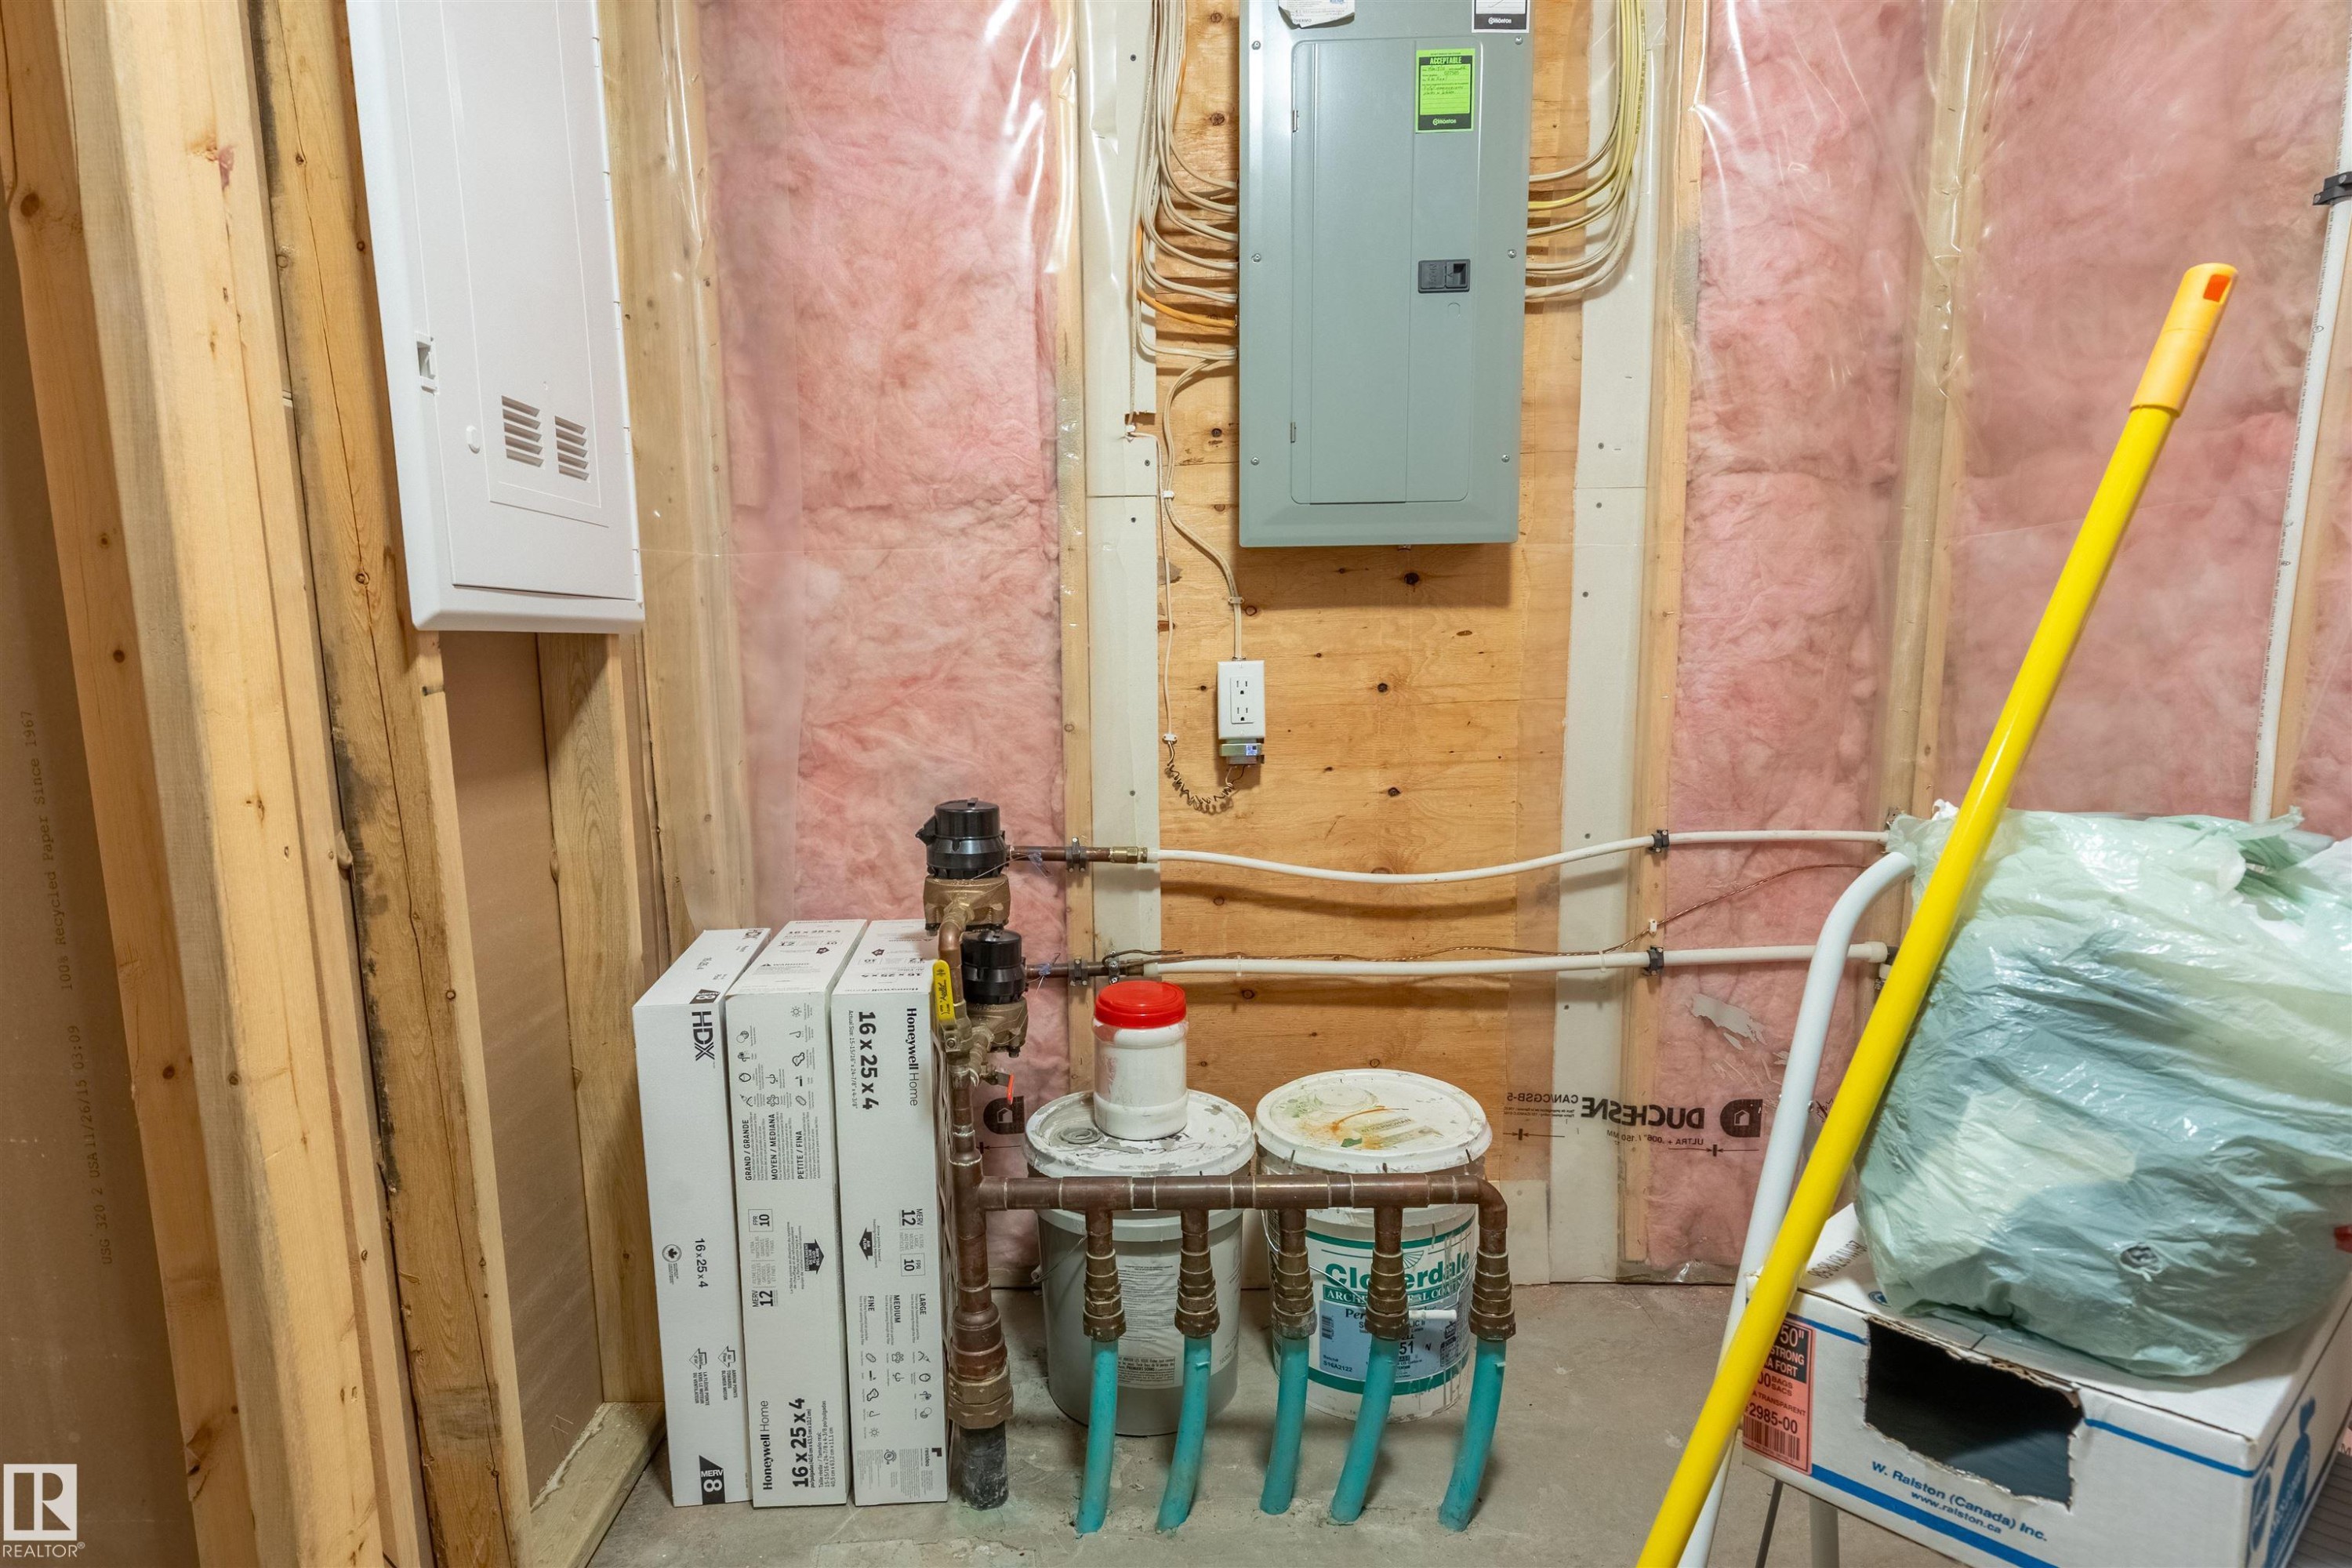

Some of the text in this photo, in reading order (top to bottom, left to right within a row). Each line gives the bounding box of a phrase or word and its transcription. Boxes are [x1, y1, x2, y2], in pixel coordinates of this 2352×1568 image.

[1430, 56, 1463, 65] ACCEPTABLE
[20, 711, 72, 990] 100% Recycled Paper Since 1967
[67, 1025, 84, 1069] 03:09
[691, 1011, 715, 1062] HDX
[858, 1011, 879, 1109] 16 x 25 x 4
[906, 1008, 919, 1106] Honeywell Home
[742, 1120, 750, 1149] GRANDE
[94, 1205, 107, 1229] 320
[759, 1214, 770, 1227] 10
[901, 1210, 916, 1226] 12
[100, 1239, 112, 1264] USG
[695, 1238, 706, 1251] 16
[696, 1258, 707, 1272] 25
[904, 1259, 915, 1272] 10
[1325, 1252, 1469, 1290] Cloerdale
[759, 1290, 773, 1307] 12
[1775, 1361, 1798, 1377] FORT
[1771, 1375, 1793, 1389] BAGS
[1771, 1383, 1792, 1397] SACS
[1759, 1392, 1806, 1416] TRANSPARENT
[760, 1401, 773, 1490] Honeywell Home
[789, 1399, 808, 1487] 16 x 25 x 4
[703, 1479, 723, 1492] 8
[1871, 1461, 2048, 1542] W. Ralston (Canada) Inc.
[1911, 1491, 2002, 1534] www.ralston.ca
